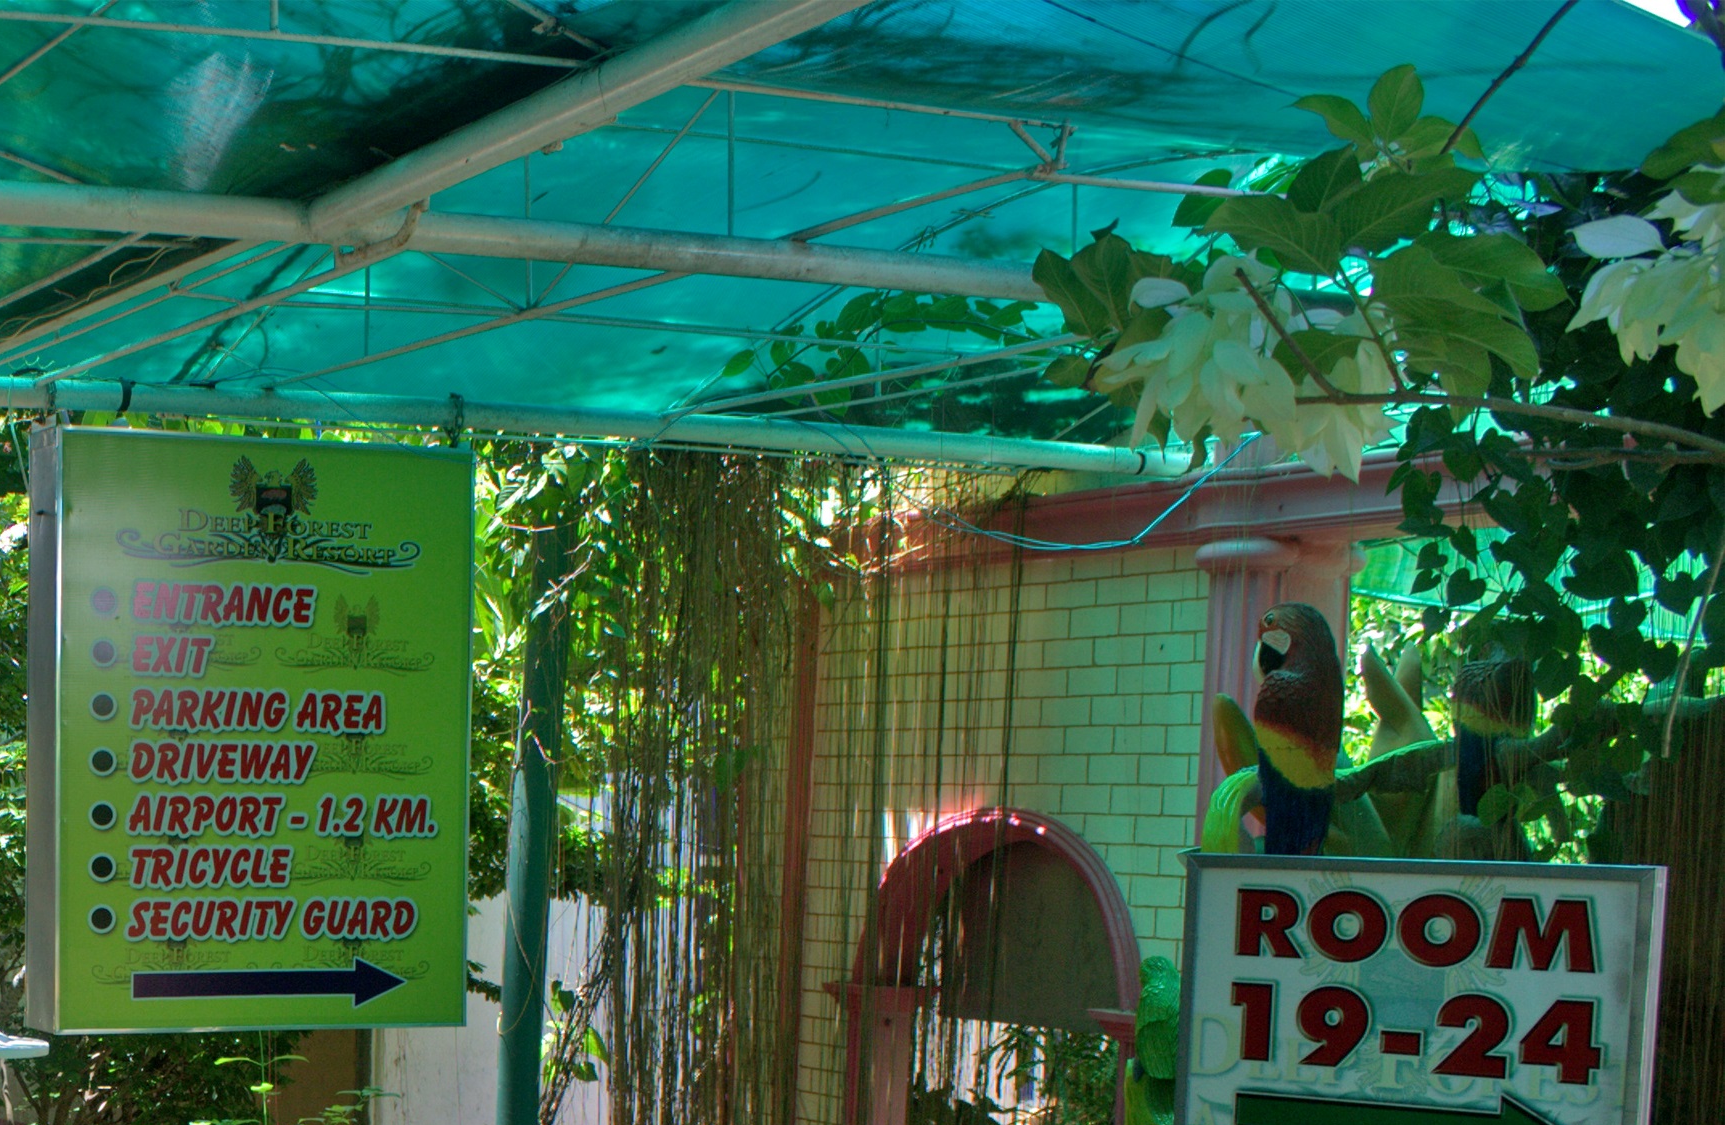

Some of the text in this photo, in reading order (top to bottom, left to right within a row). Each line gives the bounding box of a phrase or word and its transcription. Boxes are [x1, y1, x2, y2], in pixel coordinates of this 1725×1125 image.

[178, 507, 372, 540] DEEP FOREST
[153, 532, 396, 564] GARDEN RESORT
[132, 581, 315, 624] ENTRANCE
[132, 635, 212, 674] EXIT
[130, 688, 383, 731] PARKING AREA
[130, 742, 315, 782] DRIVEWAY
[128, 795, 436, 836] AIRPORT - 1.2 KM.
[131, 848, 292, 888] TRICYCLE
[127, 900, 415, 939] SECURITY GUARD
[1234, 887, 1597, 974] ROOM
[1230, 981, 1602, 1086] 19-24
